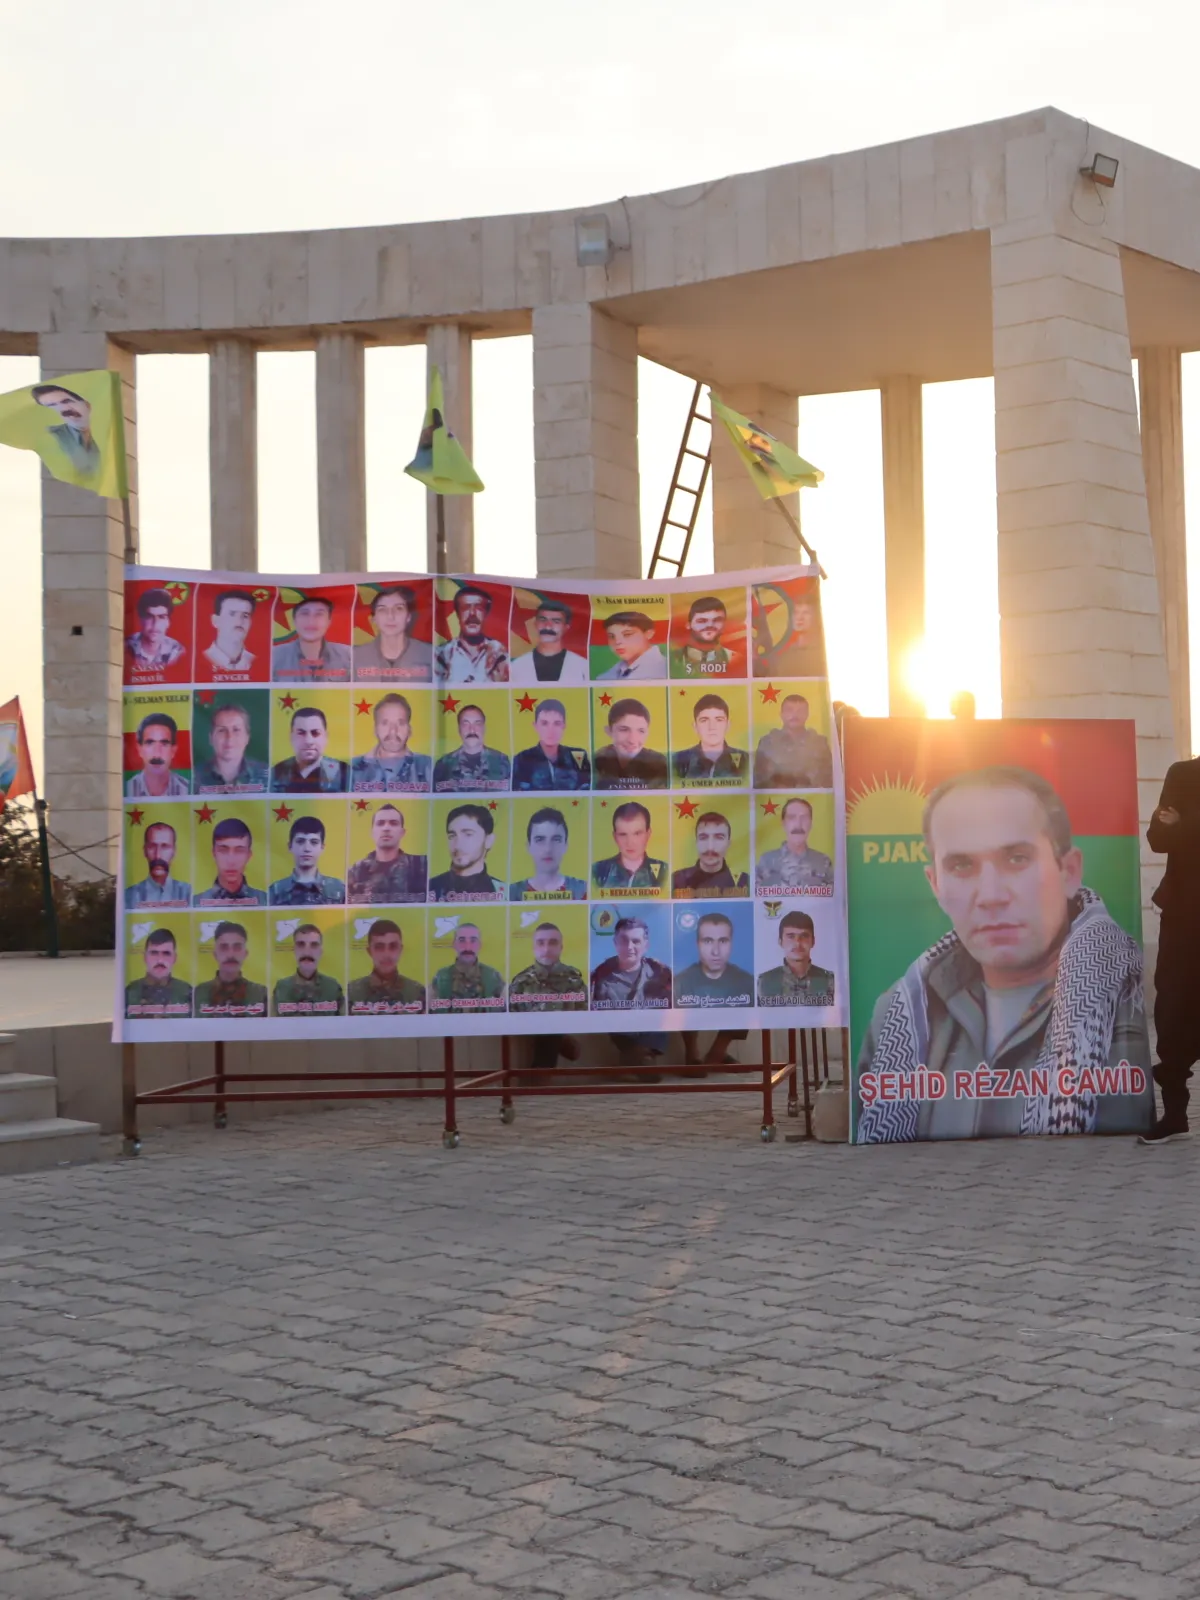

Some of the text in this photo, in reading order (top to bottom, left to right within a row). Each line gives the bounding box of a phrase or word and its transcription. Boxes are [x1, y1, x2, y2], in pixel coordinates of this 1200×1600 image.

[863, 841, 929, 863] PJAK
[784, 887, 802, 895] CAN
[860, 1059, 1146, 1107] ŞEHÎD RÊZAN CAWÎD
